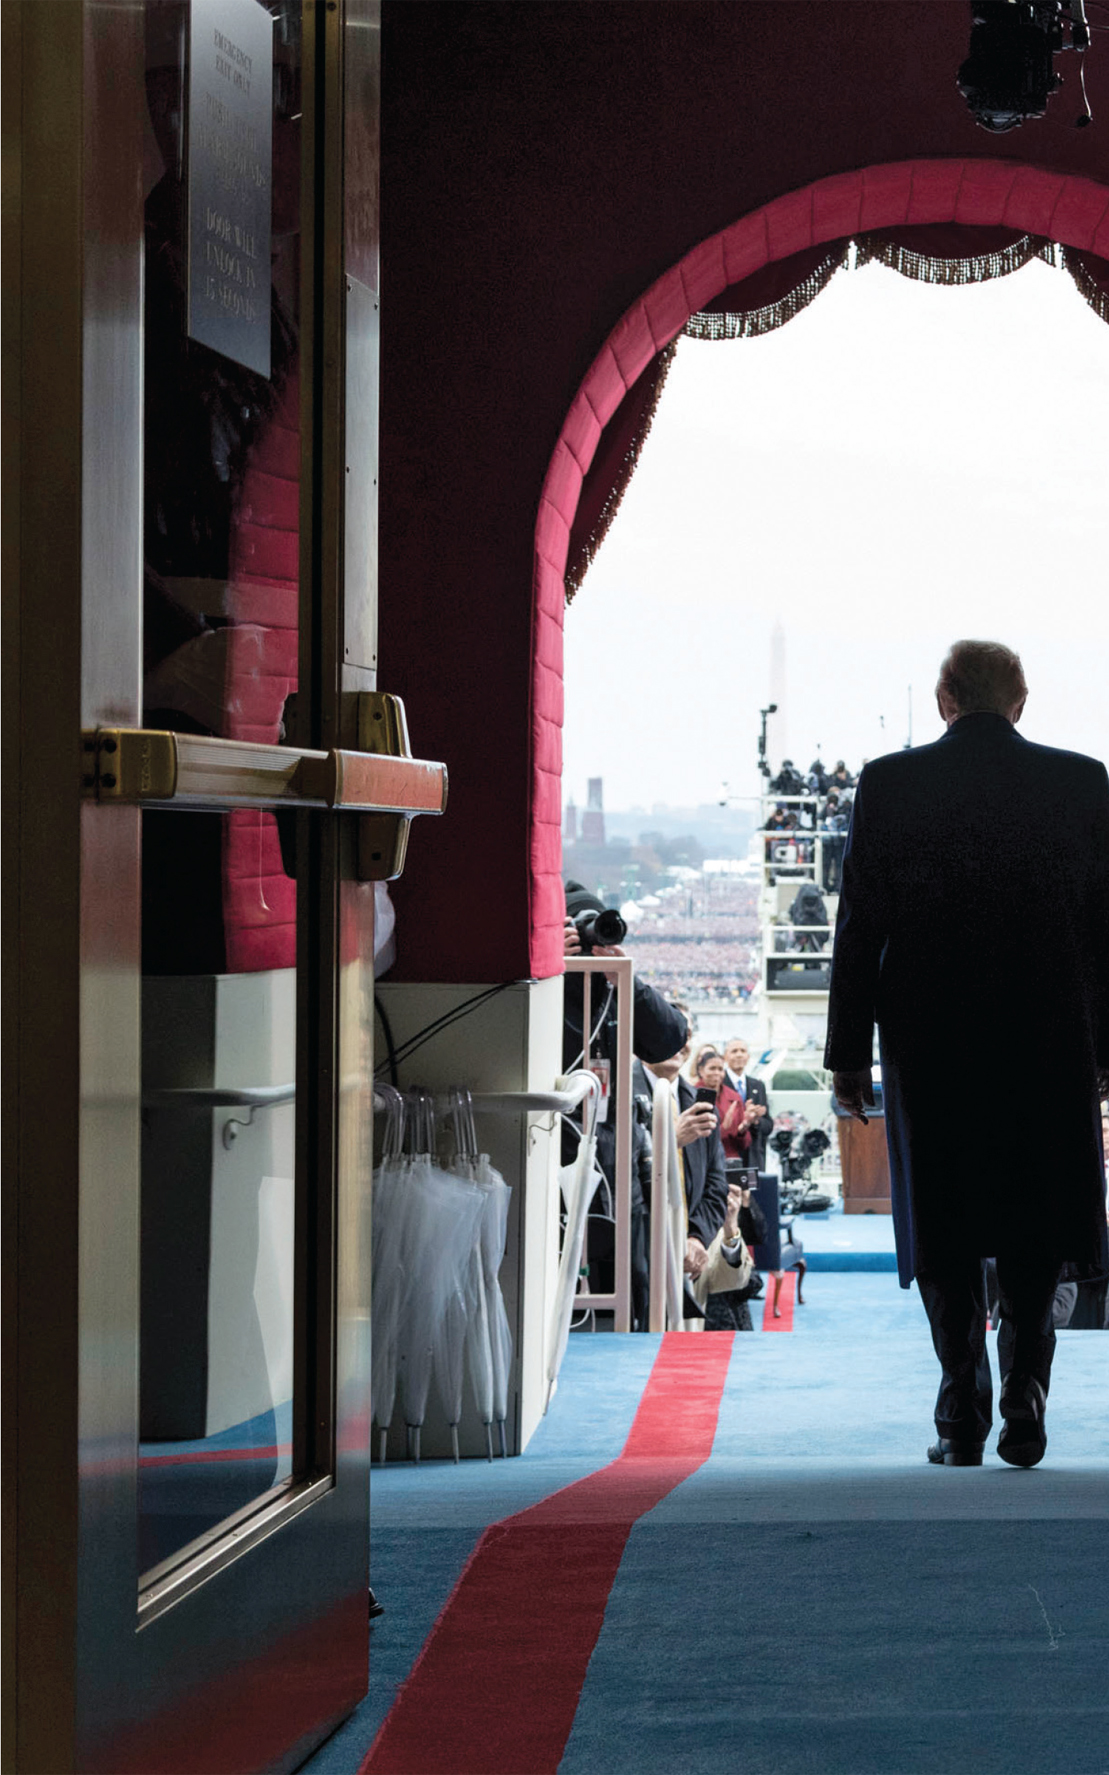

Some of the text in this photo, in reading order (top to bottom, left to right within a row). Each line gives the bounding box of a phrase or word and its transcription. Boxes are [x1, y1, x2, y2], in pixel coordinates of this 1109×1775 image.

[214, 28, 253, 75] EMERGENCY
[215, 54, 251, 98] EXIT ONLY
